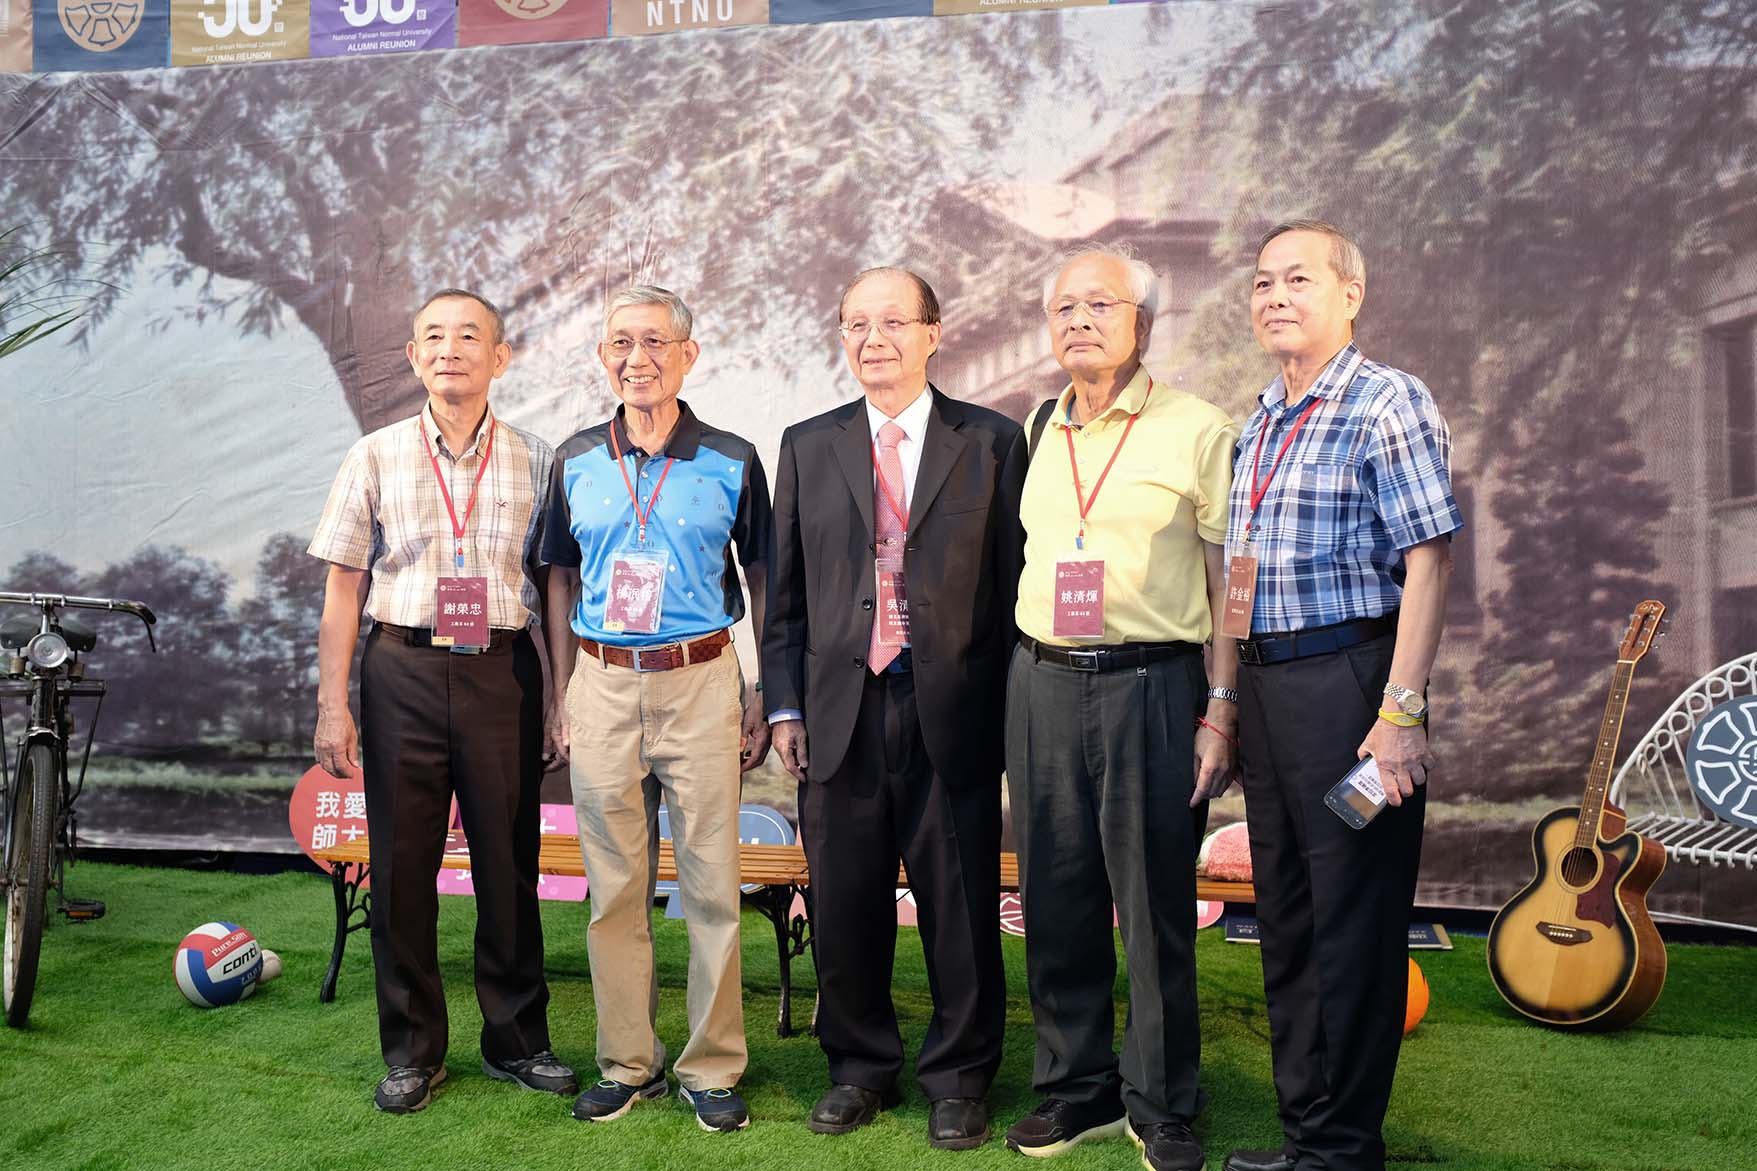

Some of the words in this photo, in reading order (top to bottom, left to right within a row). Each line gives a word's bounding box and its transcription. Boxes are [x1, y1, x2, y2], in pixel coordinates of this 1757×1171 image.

[646, 0, 734, 27] NTNU
[402, 27, 432, 37] University
[347, 42, 378, 52] ALUMNI
[379, 39, 416, 49] REUNION
[205, 54, 235, 64] ALUMNI
[236, 51, 272, 61] REUNION
[443, 602, 482, 616] 謝榮忠
[316, 791, 367, 819] 我愛
[311, 823, 366, 850] 師大
